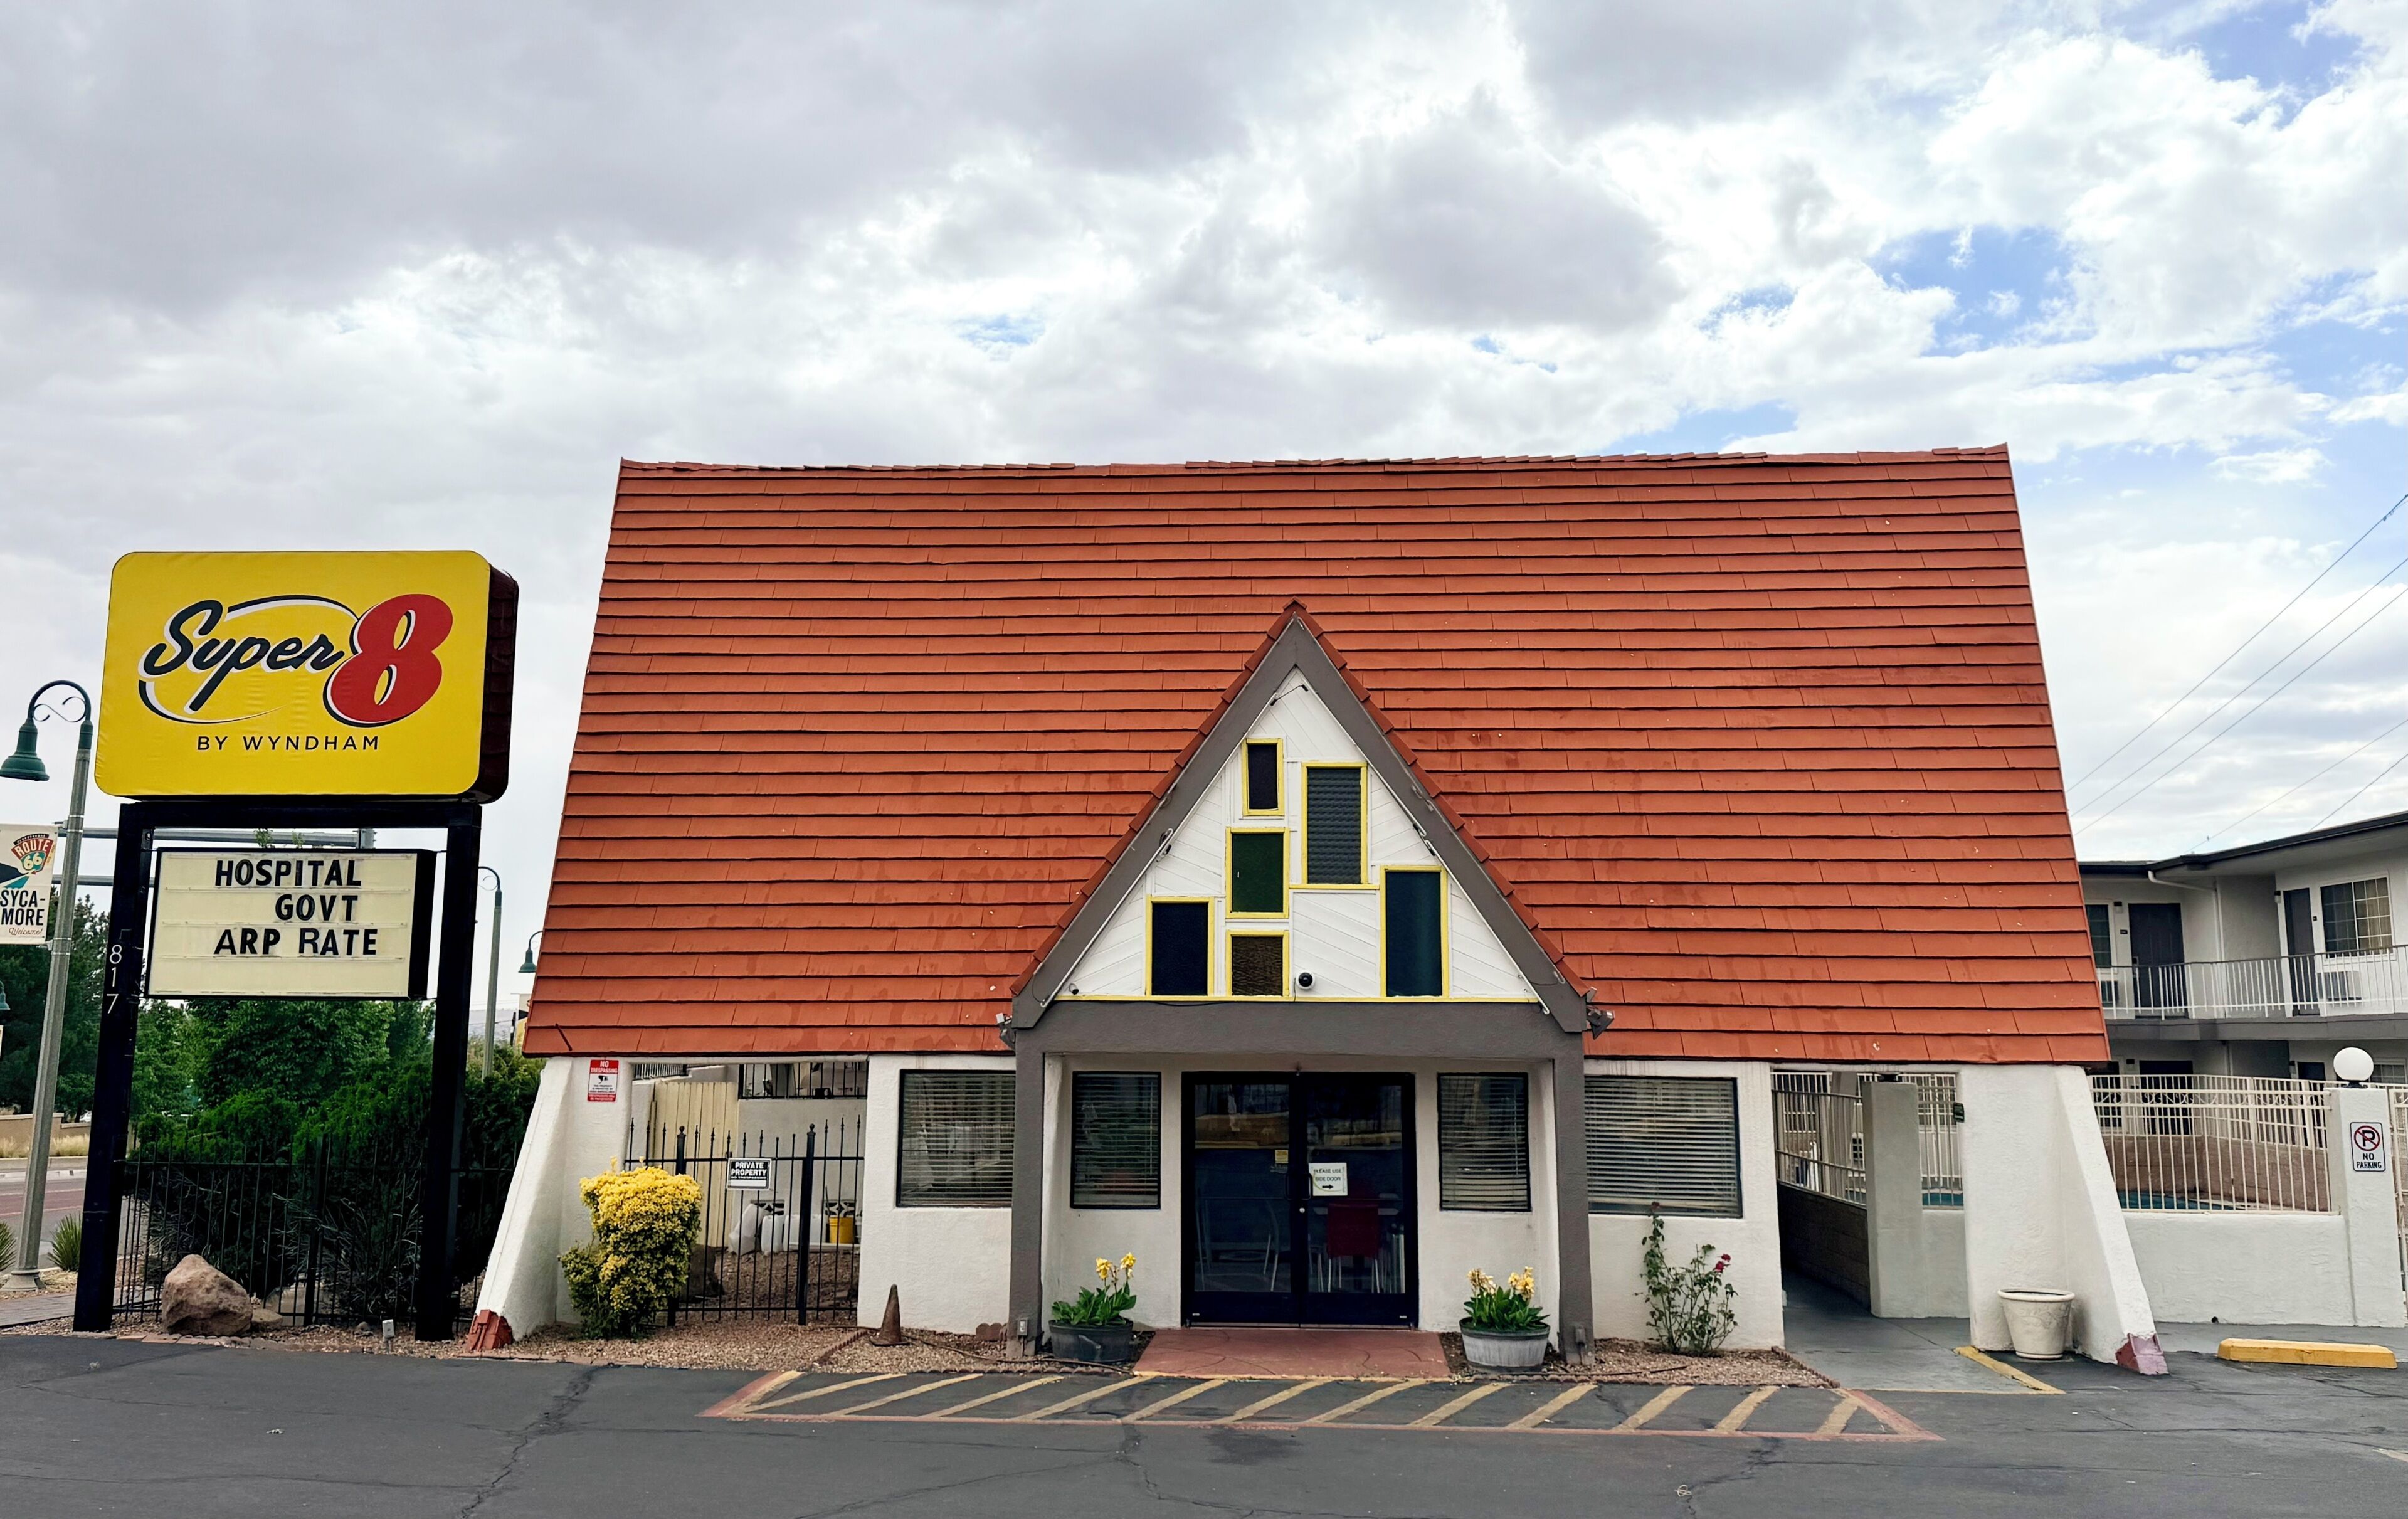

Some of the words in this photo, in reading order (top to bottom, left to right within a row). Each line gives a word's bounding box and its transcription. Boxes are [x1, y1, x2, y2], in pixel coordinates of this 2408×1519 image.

[139, 599, 345, 714] Super
[323, 593, 453, 728] 8
[198, 736, 228, 750] BY
[243, 736, 379, 750] WYNDHAM
[15, 838, 51, 857] ROUTE
[23, 852, 43, 870] 66
[215, 859, 362, 886] HOSPITAL
[0, 889, 45, 908] SYCA-
[275, 894, 359, 921] GOVT
[1, 909, 45, 926] MORE
[214, 929, 281, 955] ARP
[298, 928, 378, 955] RATE
[106, 945, 122, 1014] 817
